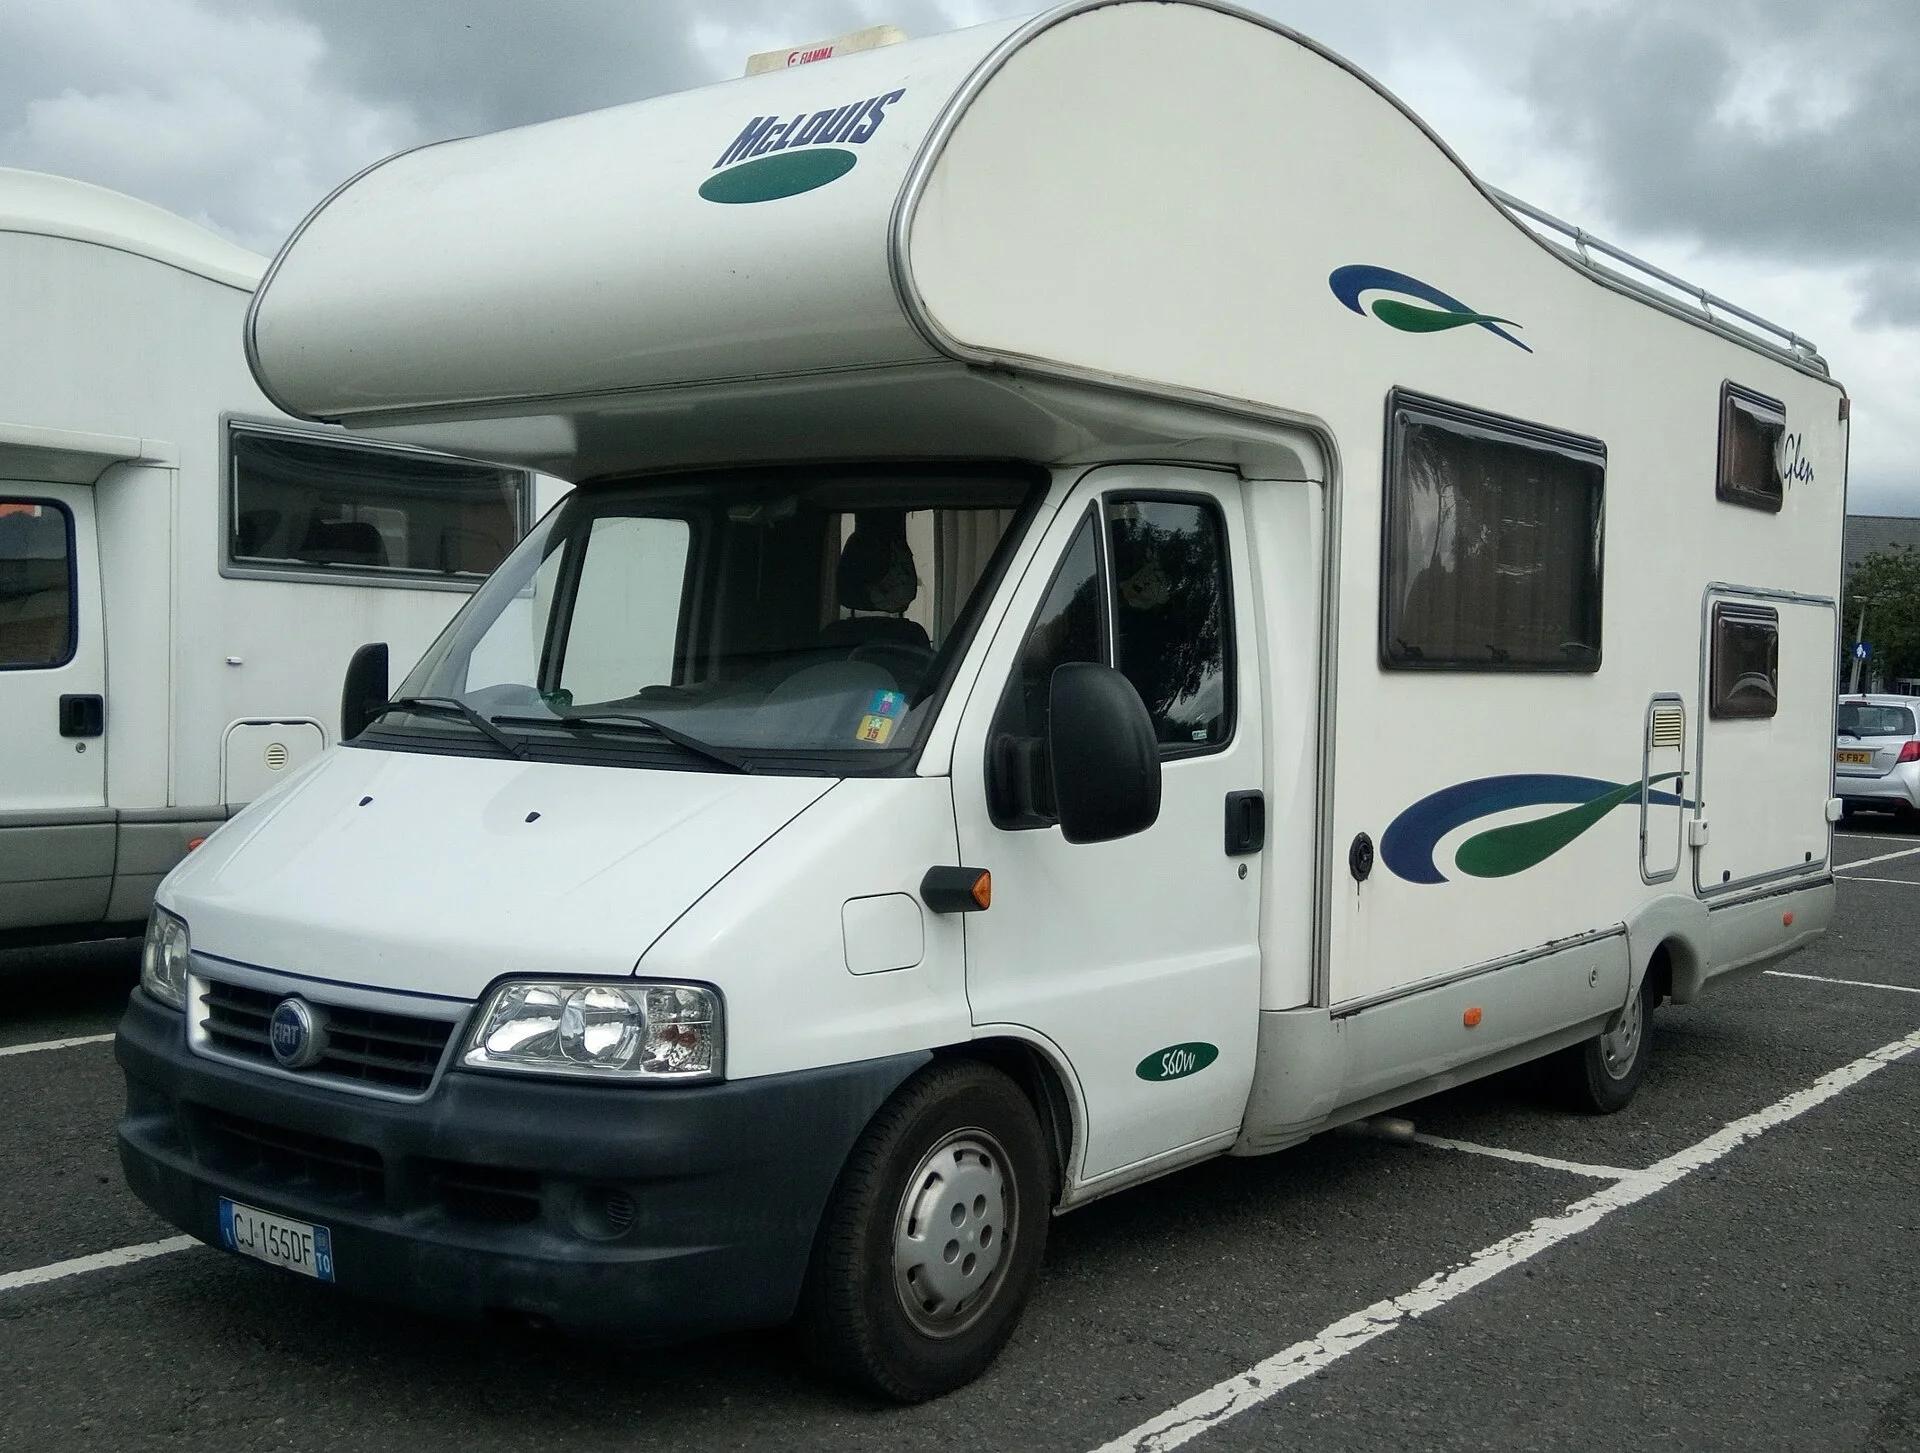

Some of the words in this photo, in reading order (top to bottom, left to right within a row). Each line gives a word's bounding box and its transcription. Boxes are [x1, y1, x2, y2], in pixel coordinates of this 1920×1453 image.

[799, 46, 834, 65] FIAMMA
[1783, 433, 1815, 491] Glen
[273, 1022, 300, 1045] FIAT
